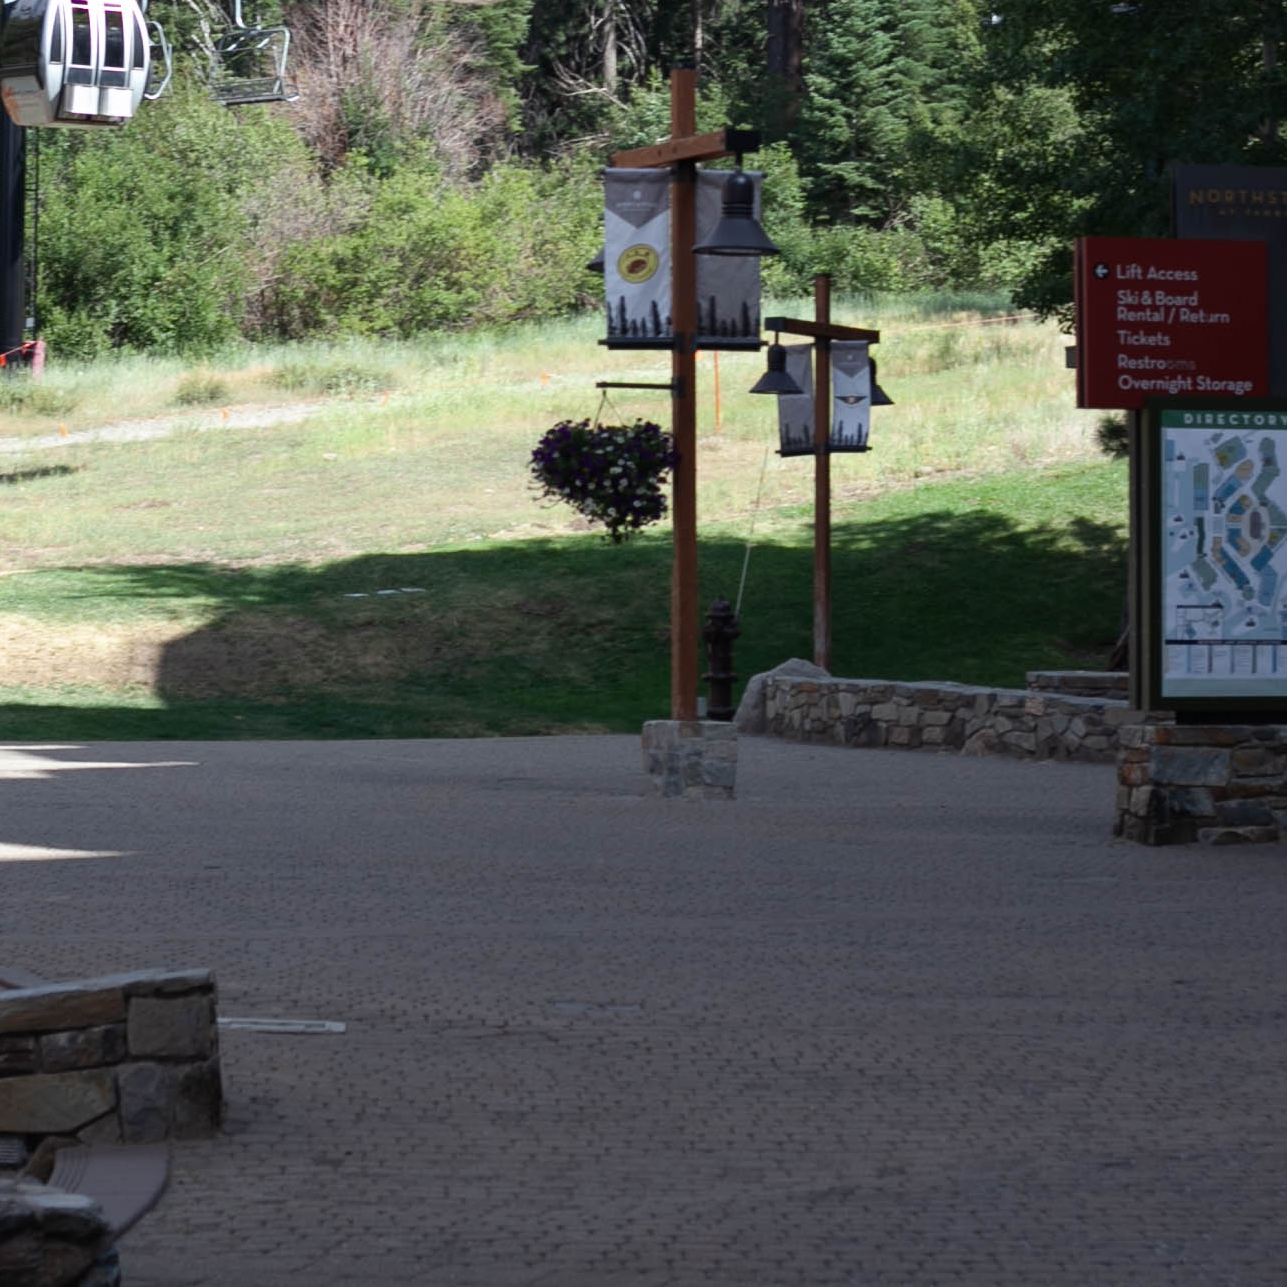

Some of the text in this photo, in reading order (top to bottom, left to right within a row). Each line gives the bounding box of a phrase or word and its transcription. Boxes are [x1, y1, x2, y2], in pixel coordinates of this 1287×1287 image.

[1116, 263, 1199, 281] Lift Access
[1117, 289, 1199, 306] Ski & Board
[1117, 306, 1165, 322] Rental
[1167, 307, 1176, 325] /
[1117, 330, 1171, 346] Tickets
[1118, 374, 1254, 395] Overnight Storage
